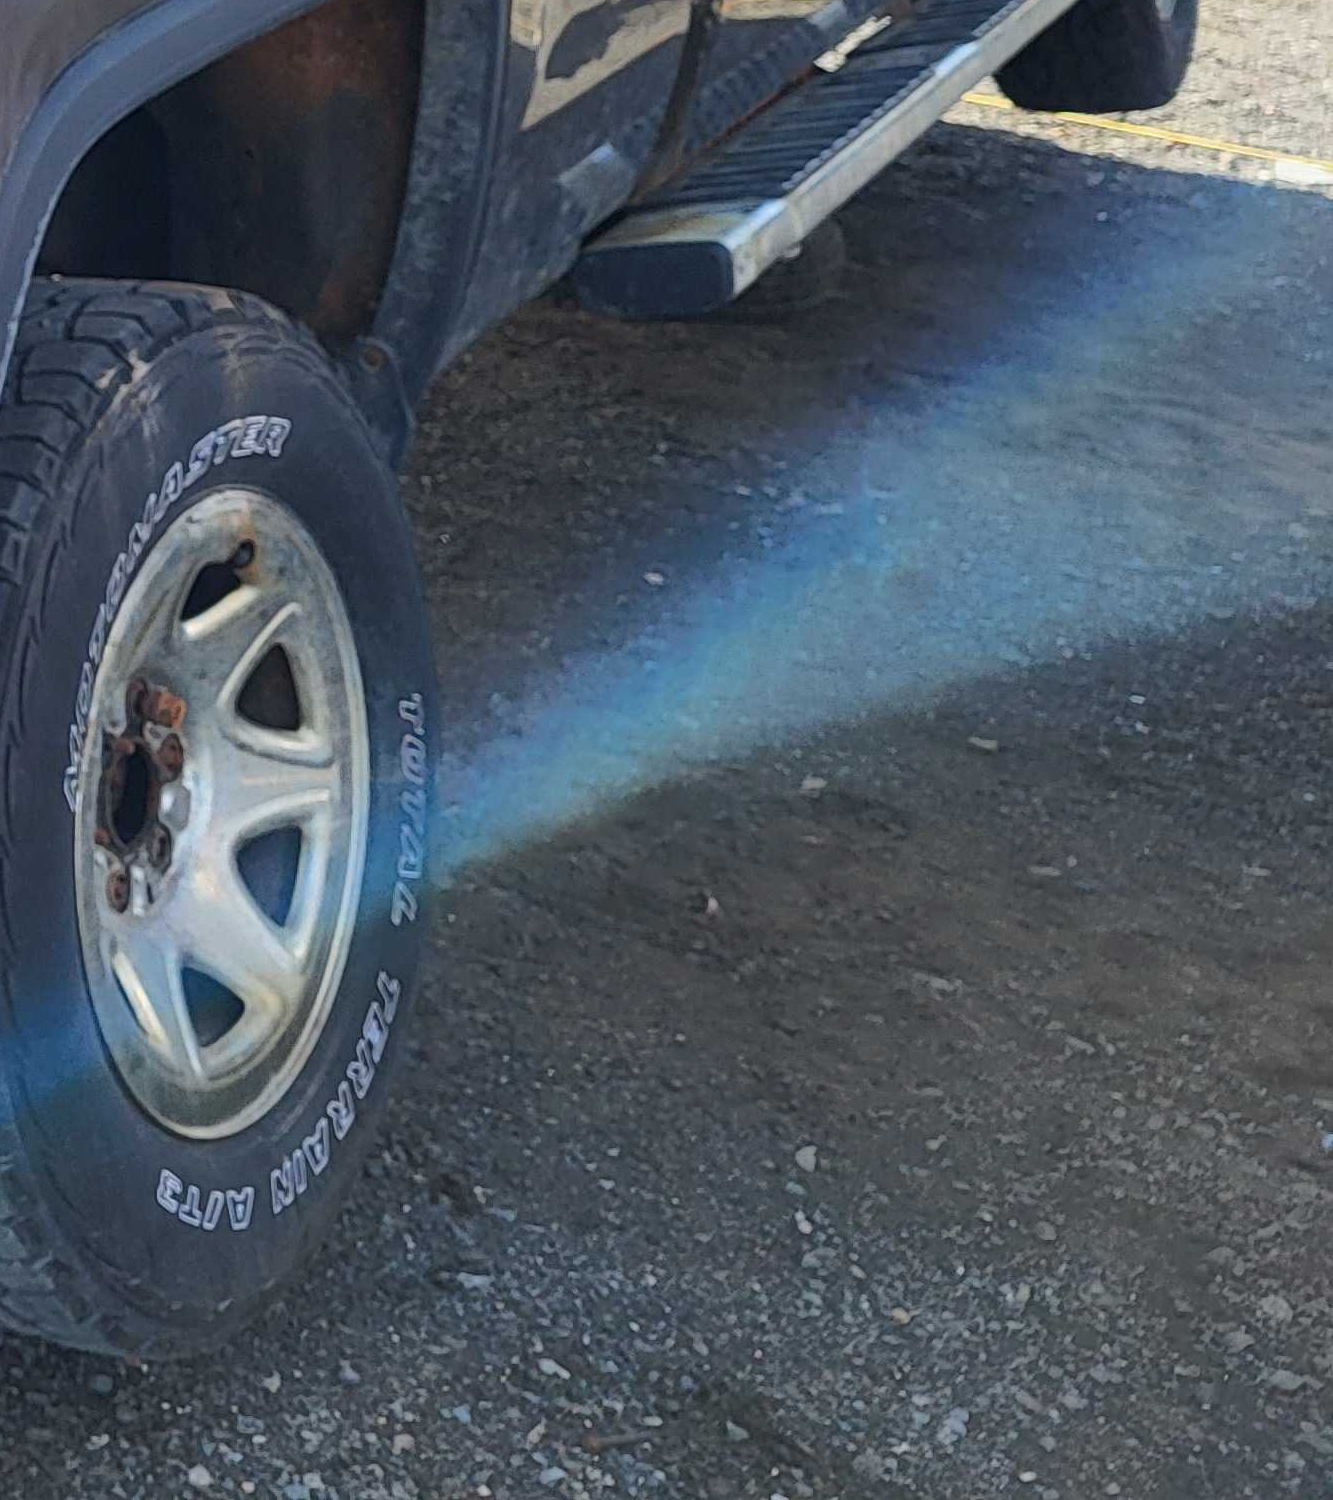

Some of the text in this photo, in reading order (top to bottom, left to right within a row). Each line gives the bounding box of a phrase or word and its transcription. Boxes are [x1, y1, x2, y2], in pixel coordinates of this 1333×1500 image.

[157, 692, 427, 1233] TOTAL TERRAIN A/T3
